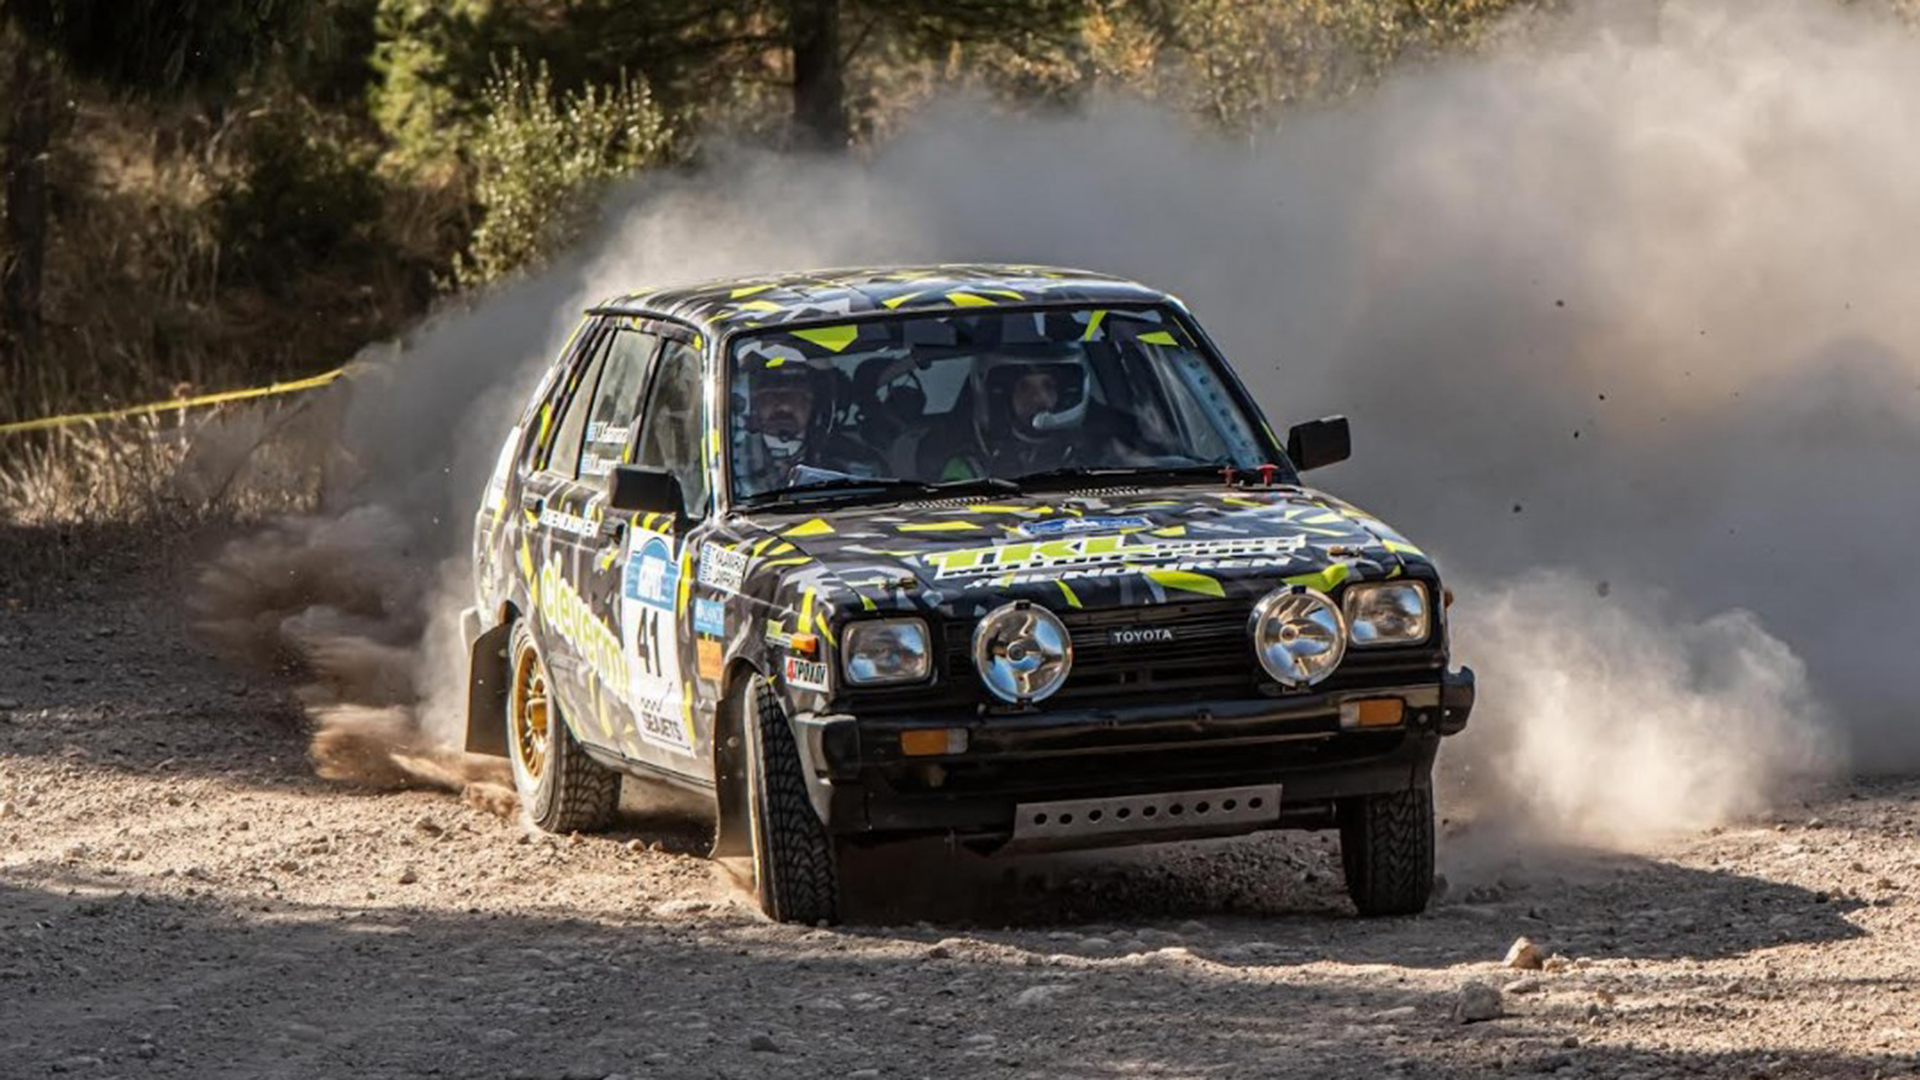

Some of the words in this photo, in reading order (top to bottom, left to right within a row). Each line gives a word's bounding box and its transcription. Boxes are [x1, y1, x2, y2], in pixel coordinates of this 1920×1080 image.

[923, 535, 1155, 570] TKL
[637, 607, 662, 677] 41
[1114, 629, 1173, 643] TOYOTA
